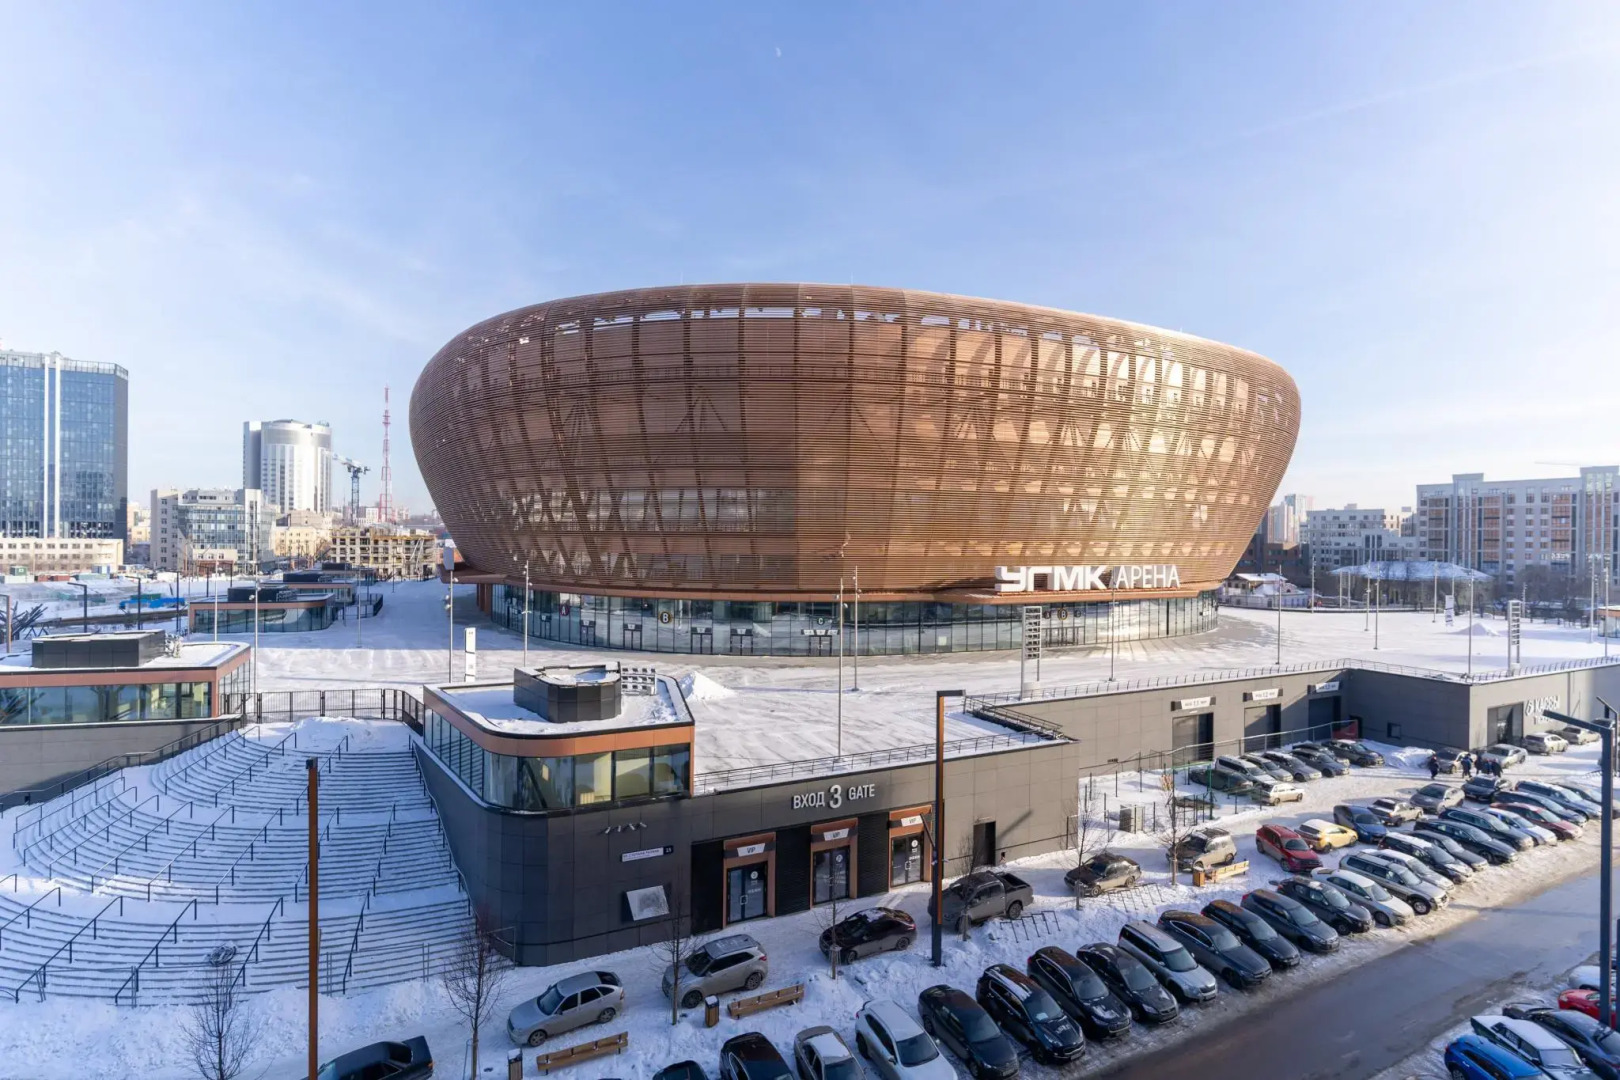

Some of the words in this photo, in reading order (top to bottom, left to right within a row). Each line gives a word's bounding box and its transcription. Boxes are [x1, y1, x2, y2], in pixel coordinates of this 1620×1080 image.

[995, 565, 1107, 592] УГМК
[1115, 564, 1180, 589] АРЕНА
[793, 791, 825, 809] ВХОД
[829, 784, 842, 809] 3
[848, 783, 875, 801] GATE
[746, 846, 756, 854] VIP
